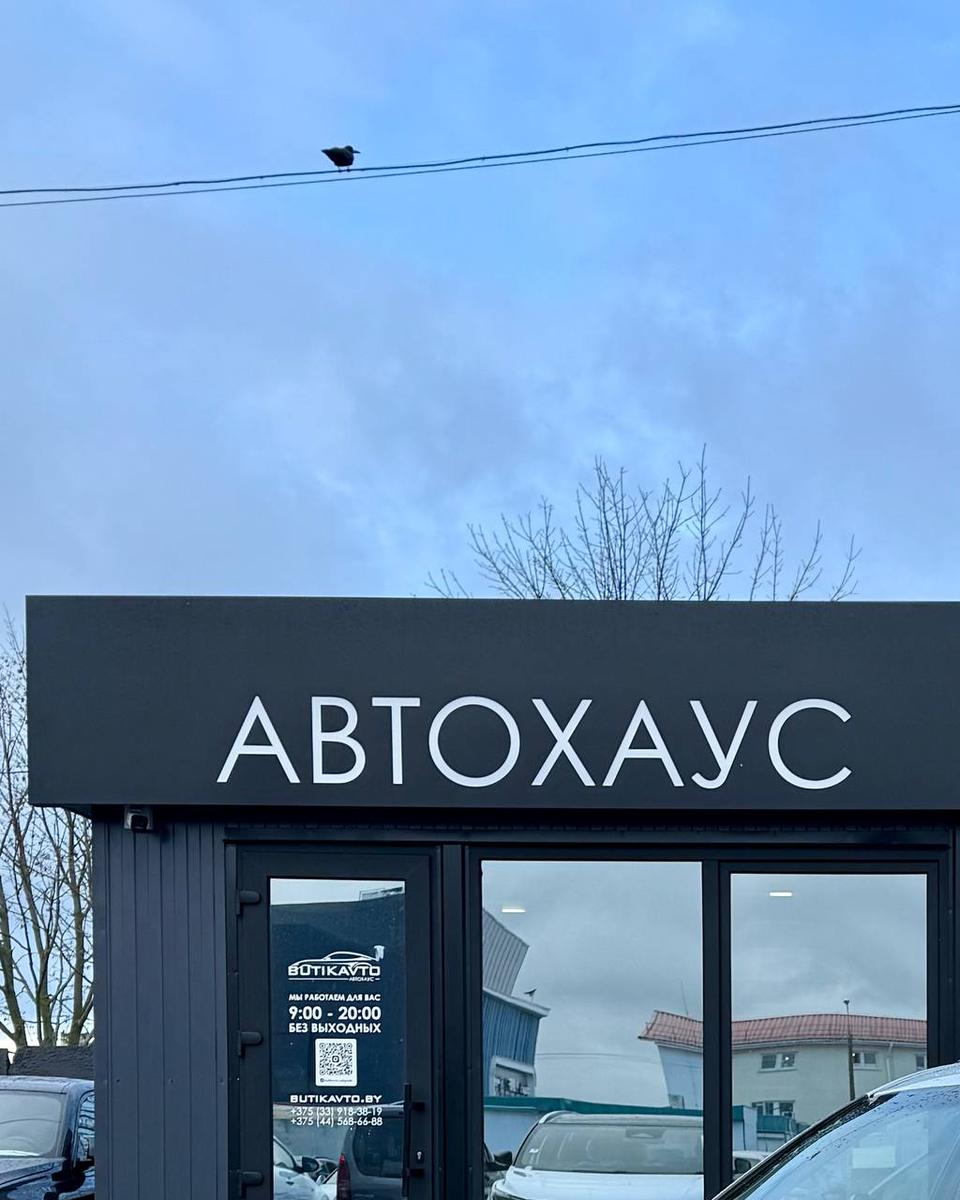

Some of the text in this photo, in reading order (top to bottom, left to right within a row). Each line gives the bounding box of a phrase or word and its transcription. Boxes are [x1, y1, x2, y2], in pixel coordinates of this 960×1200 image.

[216, 695, 853, 790] АВТОХАУС
[287, 965, 381, 976] BUTIKAVTO
[289, 993, 381, 1002] МЫ РАБОТАЕМ ДЛЯ ВАС
[288, 1005, 323, 1020] 9:00
[338, 1006, 382, 1020] 20:00
[288, 1022, 382, 1034] БЕЗ ВЫХОДНЫХ
[290, 1094, 383, 1103] BUTIKAVTO.BY
[290, 1106, 314, 1116] +375
[337, 1106, 383, 1116] 918-38-19
[290, 1116, 383, 1128] +375 (44) 568-66-88
